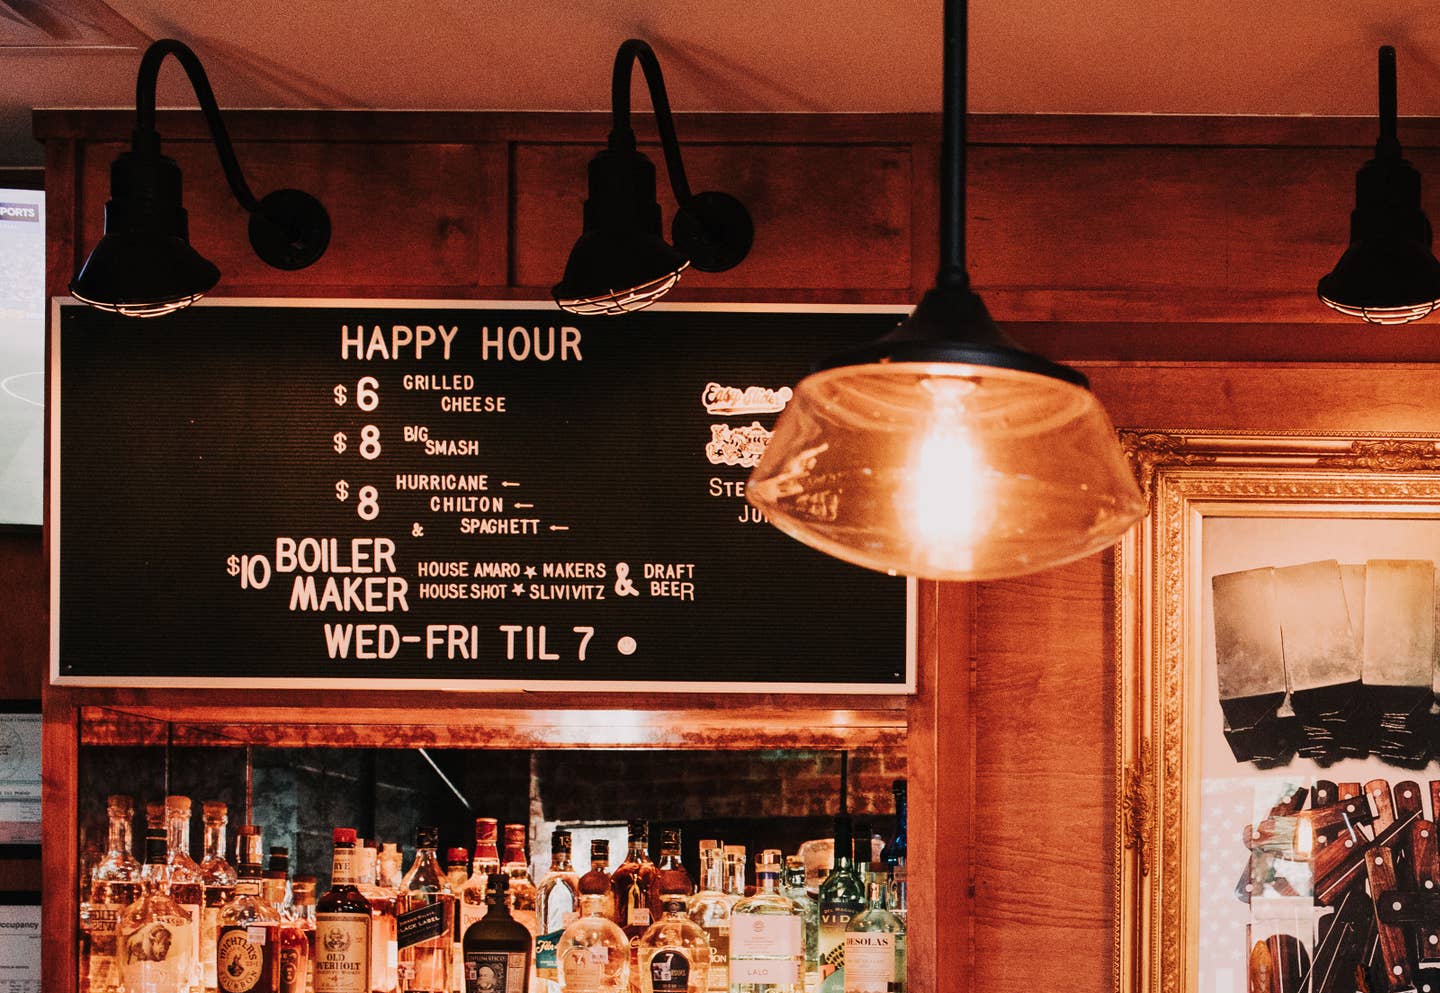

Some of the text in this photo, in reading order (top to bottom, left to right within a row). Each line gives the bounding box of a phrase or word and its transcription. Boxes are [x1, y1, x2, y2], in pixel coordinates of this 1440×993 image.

[0, 207, 35, 217] PORTS
[341, 325, 582, 361] HAPPY HOUR
[403, 374, 474, 390] GRILLED
[441, 396, 506, 412] CHEESE
[403, 426, 429, 443] BIG
[424, 439, 479, 456] SMASH
[396, 474, 488, 492] HURRICANE
[709, 477, 746, 498] STE
[430, 496, 503, 513] CHILTON
[411, 517, 540, 538] & SPAGHETT
[276, 537, 397, 574] BOILER
[226, 554, 271, 590] $10
[418, 561, 607, 579] HOUSE AMARO MAKERS
[644, 563, 695, 580] DRAFT
[614, 562, 640, 597] &
[289, 575, 409, 612] MAKER
[529, 584, 605, 600] SLIVIVITZ
[650, 581, 695, 601] BEER
[324, 623, 595, 661] WED-FRI TIL 7
[0, 921, 39, 930] ccupancy
[399, 916, 441, 933] LACK LABEL
[822, 914, 851, 923] VID
[316, 961, 361, 970] VERHOLT
